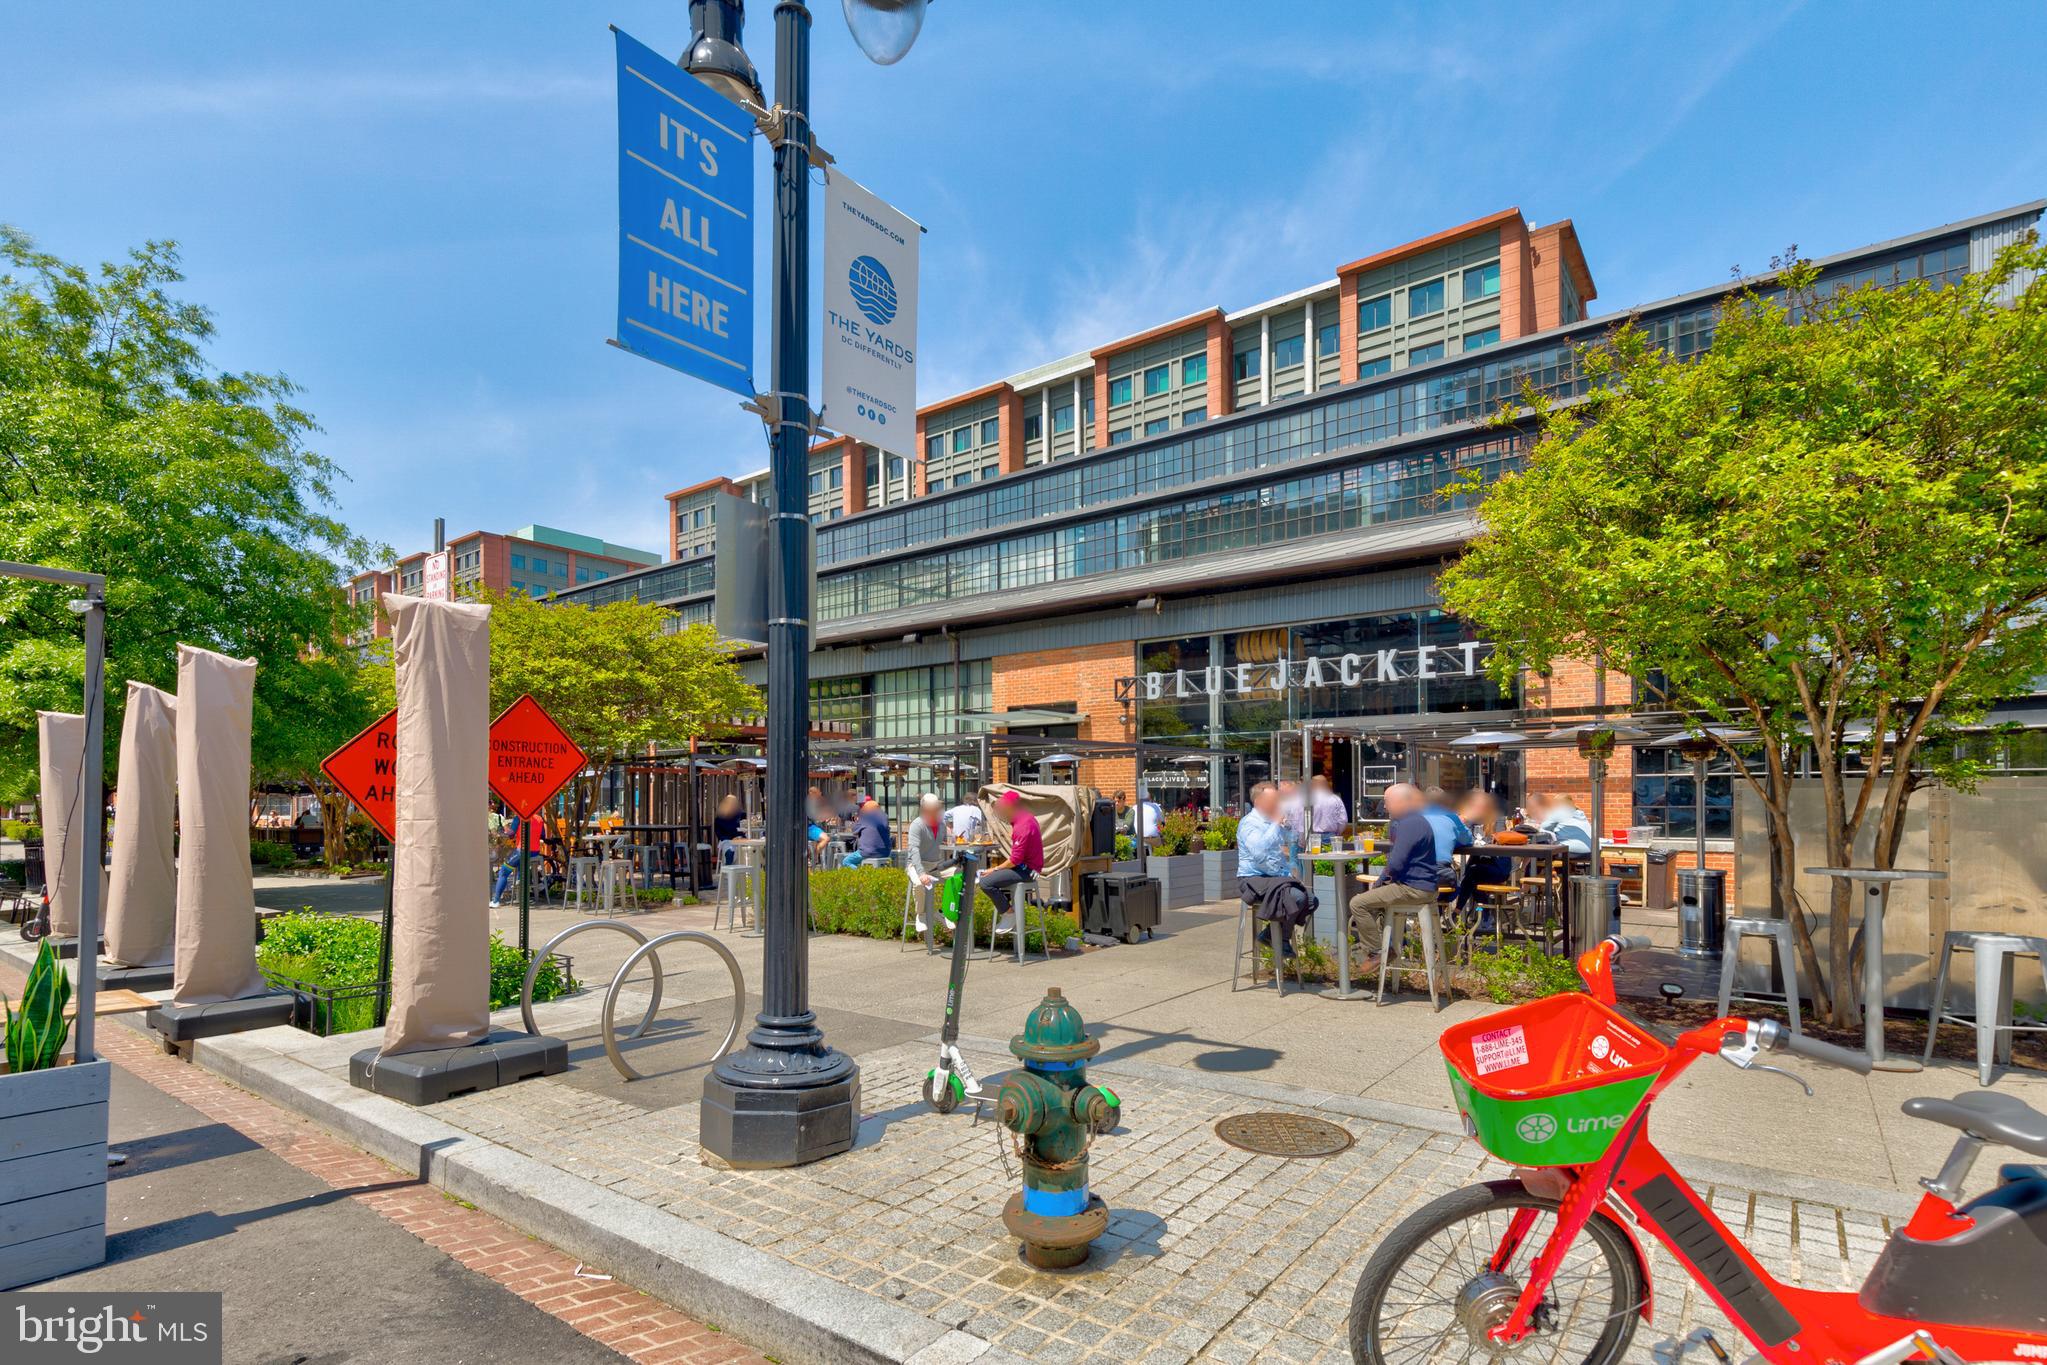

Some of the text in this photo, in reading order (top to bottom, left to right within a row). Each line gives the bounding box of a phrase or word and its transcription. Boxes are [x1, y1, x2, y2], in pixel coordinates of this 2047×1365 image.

[660, 112, 718, 177] IT'S
[660, 198, 718, 256] ALL
[842, 201, 905, 245] THEYARDSDC.COM
[649, 270, 729, 338] HERE
[828, 310, 914, 364] THE YARDS
[841, 335, 902, 371] DC DIFFERENTLY
[846, 386, 897, 414] @THEYARDSDC
[1146, 641, 1480, 700] BLUEJACKET
[498, 755, 554, 769] ENTRANCE
[508, 772, 545, 784] AHEAD
[1475, 1036, 1523, 1054] 1-888-LIME-345
[1482, 1028, 1511, 1042] CONTACT
[1610, 1049, 1632, 1068] Lim
[1567, 1114, 1625, 1133] Lime
